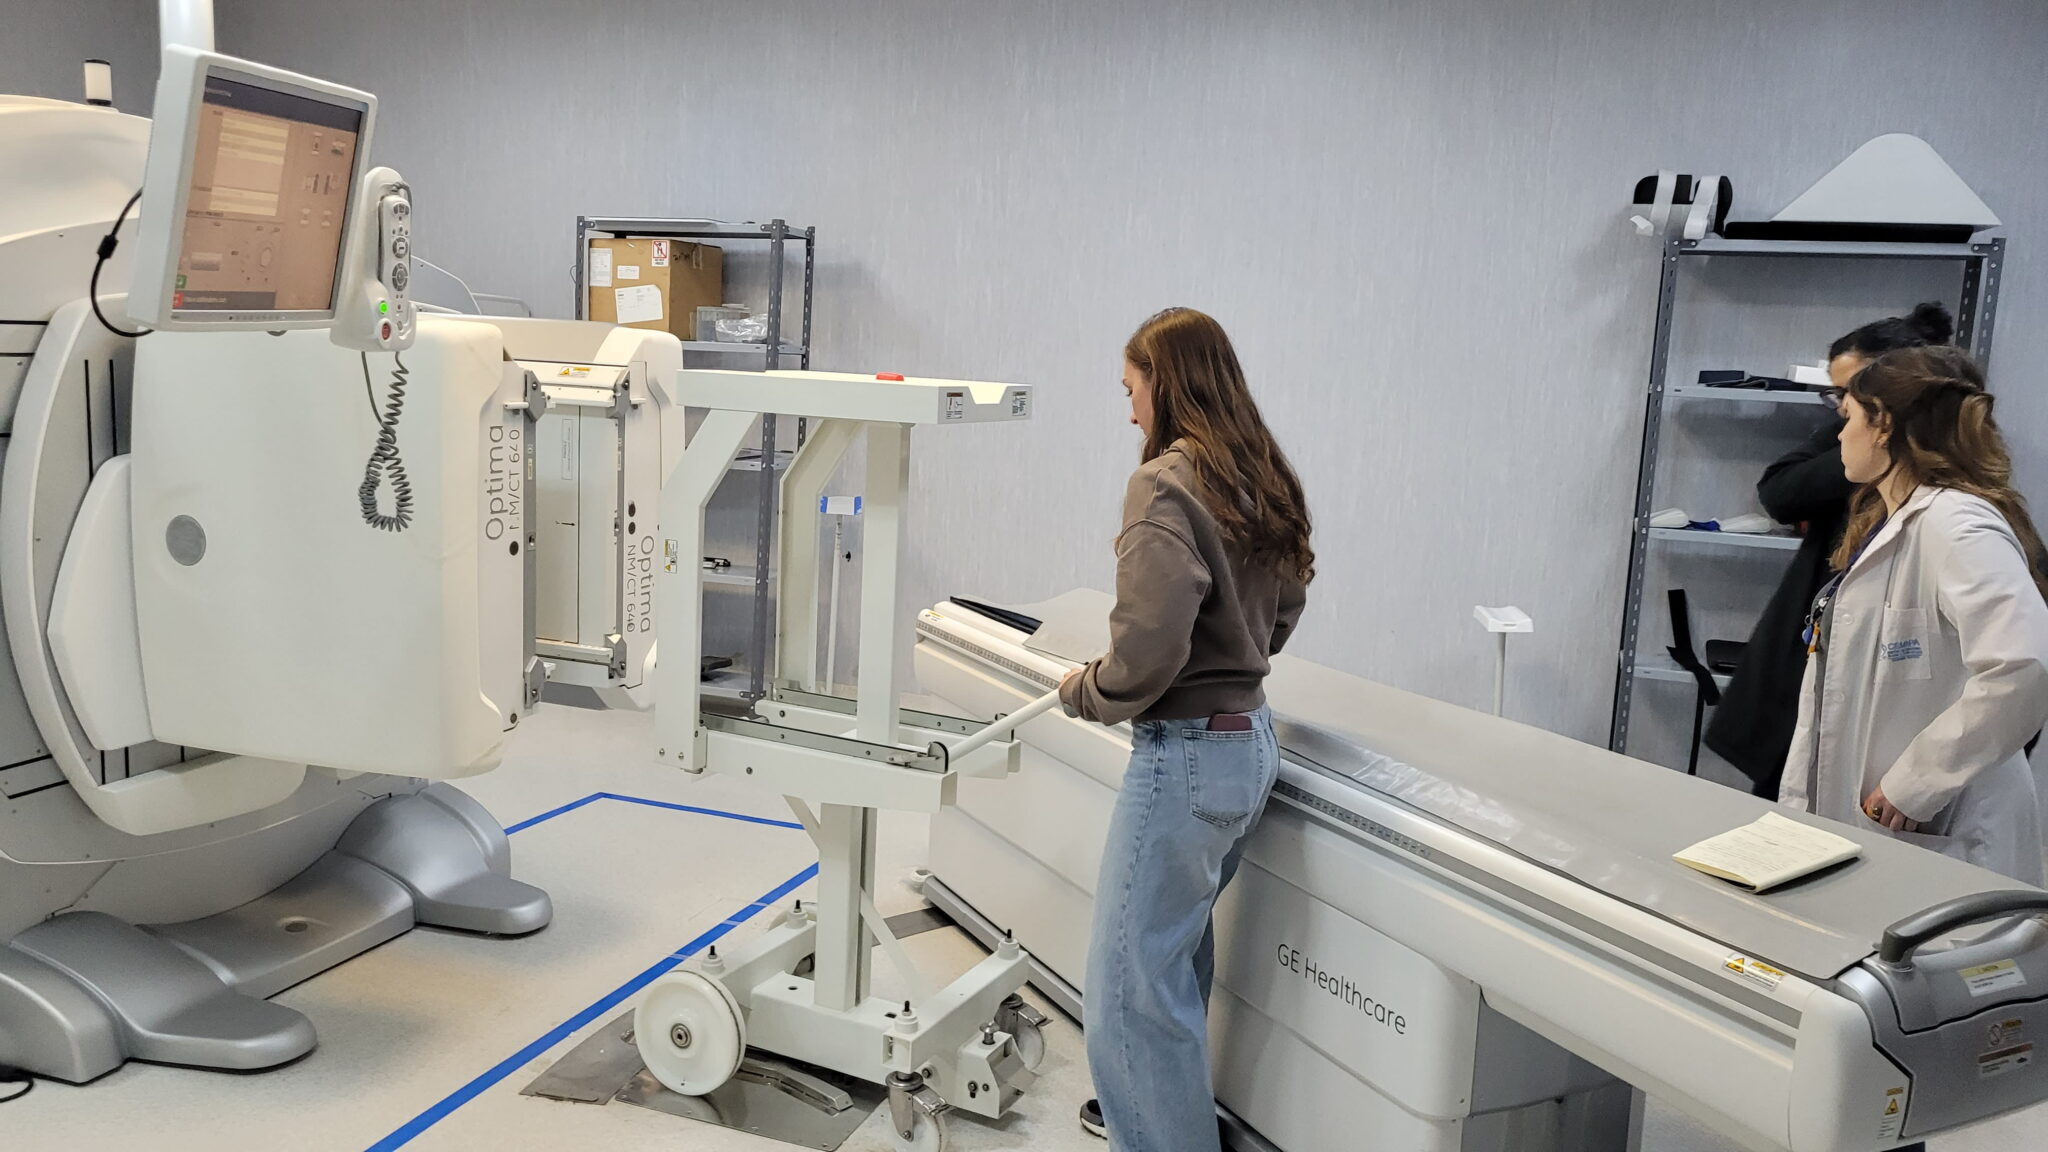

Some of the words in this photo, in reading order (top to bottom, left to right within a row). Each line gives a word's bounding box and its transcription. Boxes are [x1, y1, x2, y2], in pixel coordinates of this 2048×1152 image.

[485, 425, 508, 540] Optima
[626, 544, 638, 597] NM/CT
[637, 535, 655, 633] Optima
[626, 603, 636, 633] 640
[1278, 944, 1300, 973] GE
[1304, 957, 1406, 1034] Healthcare
